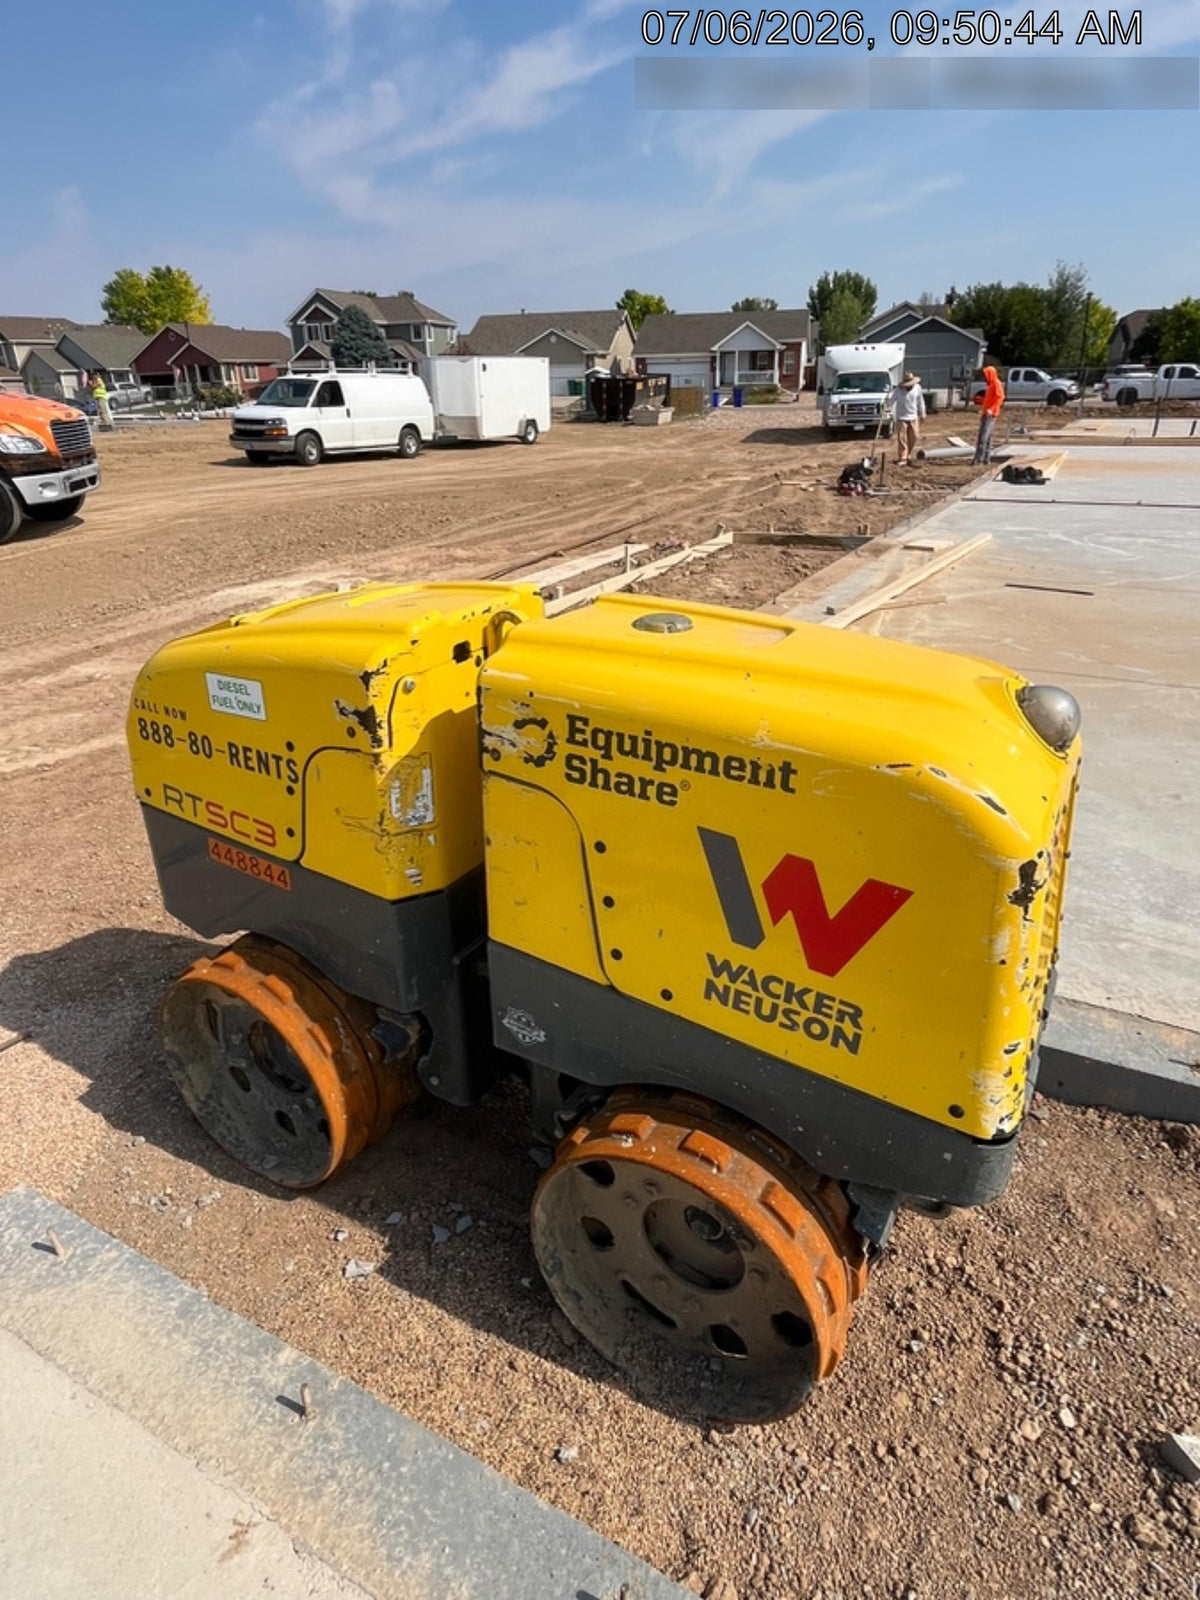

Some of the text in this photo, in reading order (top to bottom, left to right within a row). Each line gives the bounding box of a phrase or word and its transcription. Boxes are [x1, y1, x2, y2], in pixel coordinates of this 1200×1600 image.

[134, 697, 187, 721] CALL NOW
[212, 694, 262, 715] FUEL ONLY
[217, 678, 251, 696] DIESEL
[137, 716, 299, 784] 888-80-RENTS
[566, 713, 798, 794] Equipment
[162, 783, 278, 848] RTSC3
[210, 841, 290, 889] 448844
[703, 979, 864, 1056] NEUSON
[705, 952, 864, 1031] WACKER
